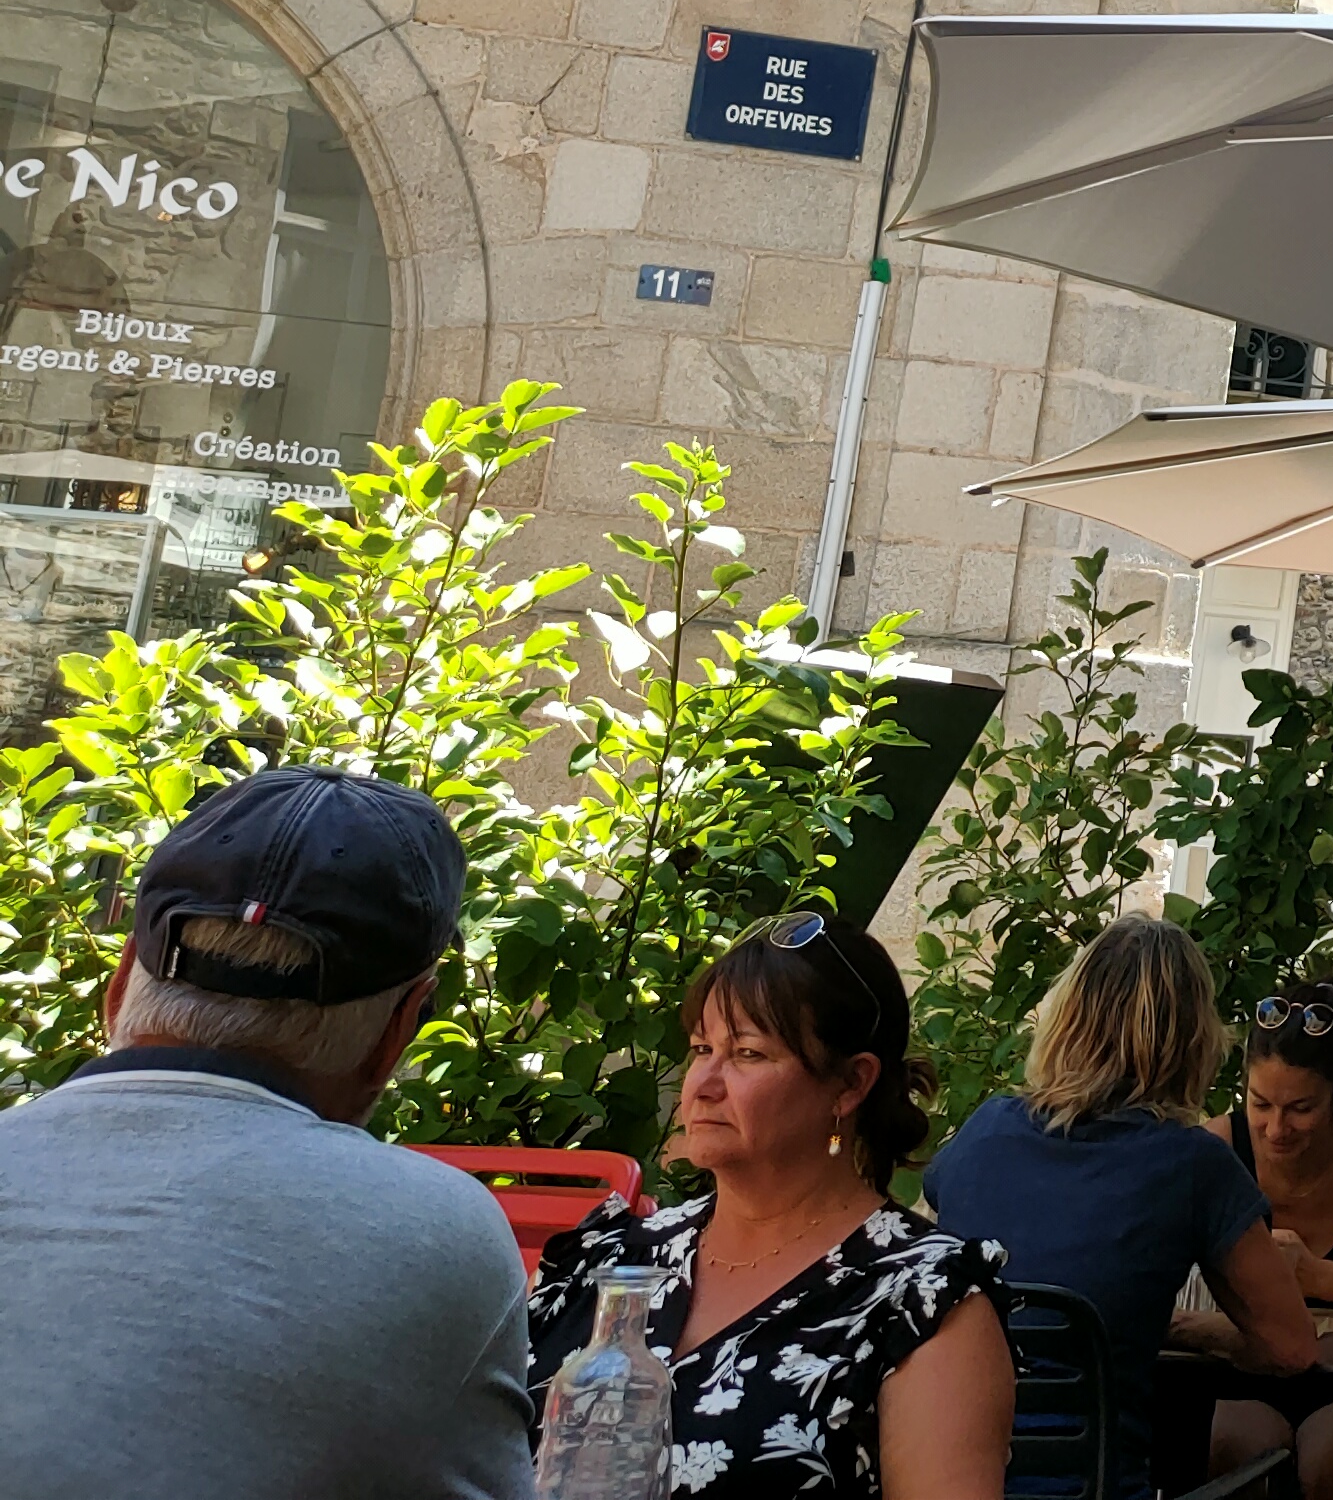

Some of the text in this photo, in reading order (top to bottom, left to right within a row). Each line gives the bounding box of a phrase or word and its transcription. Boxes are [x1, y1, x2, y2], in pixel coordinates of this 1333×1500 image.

[766, 56, 807, 79] RUE
[763, 82, 804, 104] DES
[725, 104, 833, 136] ORFEVRES
[0, 147, 238, 220] e Nico
[653, 269, 681, 299] 11
[75, 308, 196, 345] Bijoux
[0, 344, 277, 389] rgent & Pierres
[193, 431, 342, 468] Création
